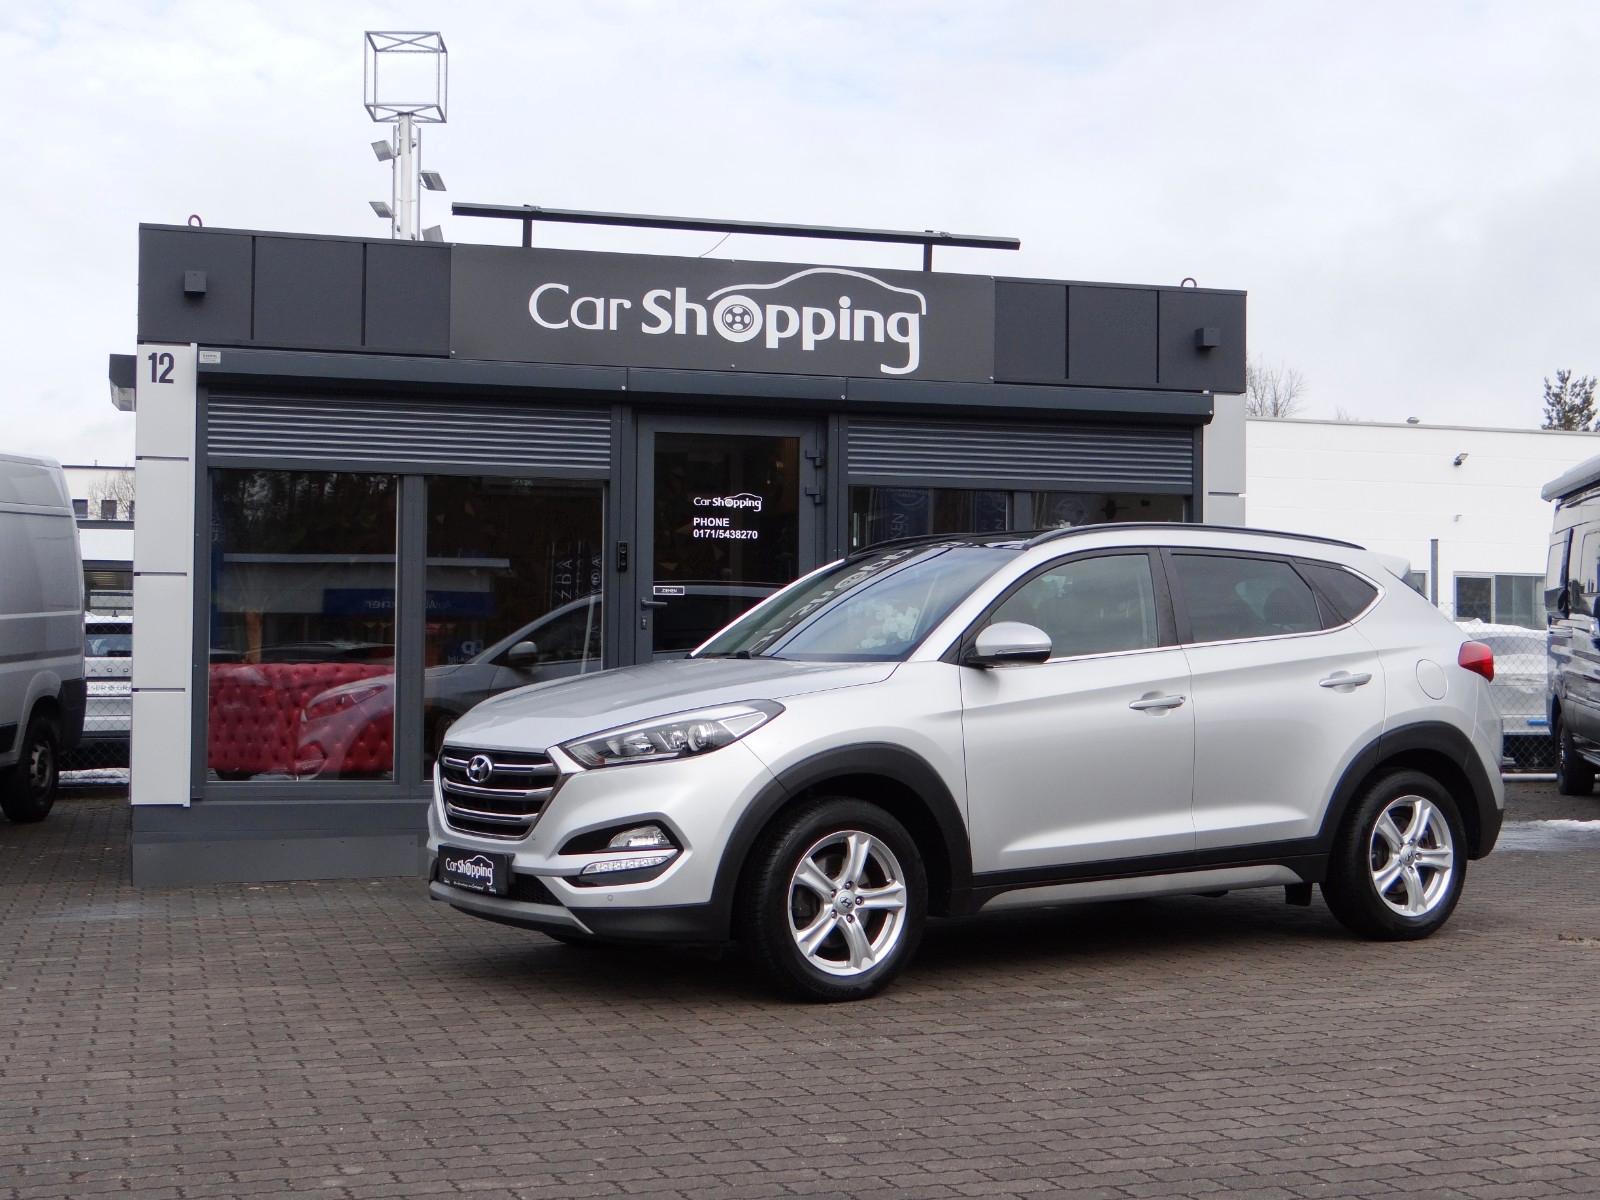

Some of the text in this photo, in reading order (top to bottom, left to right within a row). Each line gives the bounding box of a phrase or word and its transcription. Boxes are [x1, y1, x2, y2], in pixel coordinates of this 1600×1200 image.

[528, 282, 923, 375] Car Shopping
[148, 352, 175, 384] 12
[693, 495, 762, 512] Car Shopping
[693, 517, 730, 527] PHONE
[693, 529, 758, 540] 0171/5438270
[445, 857, 458, 871] Car
[457, 858, 494, 886] Shopping
